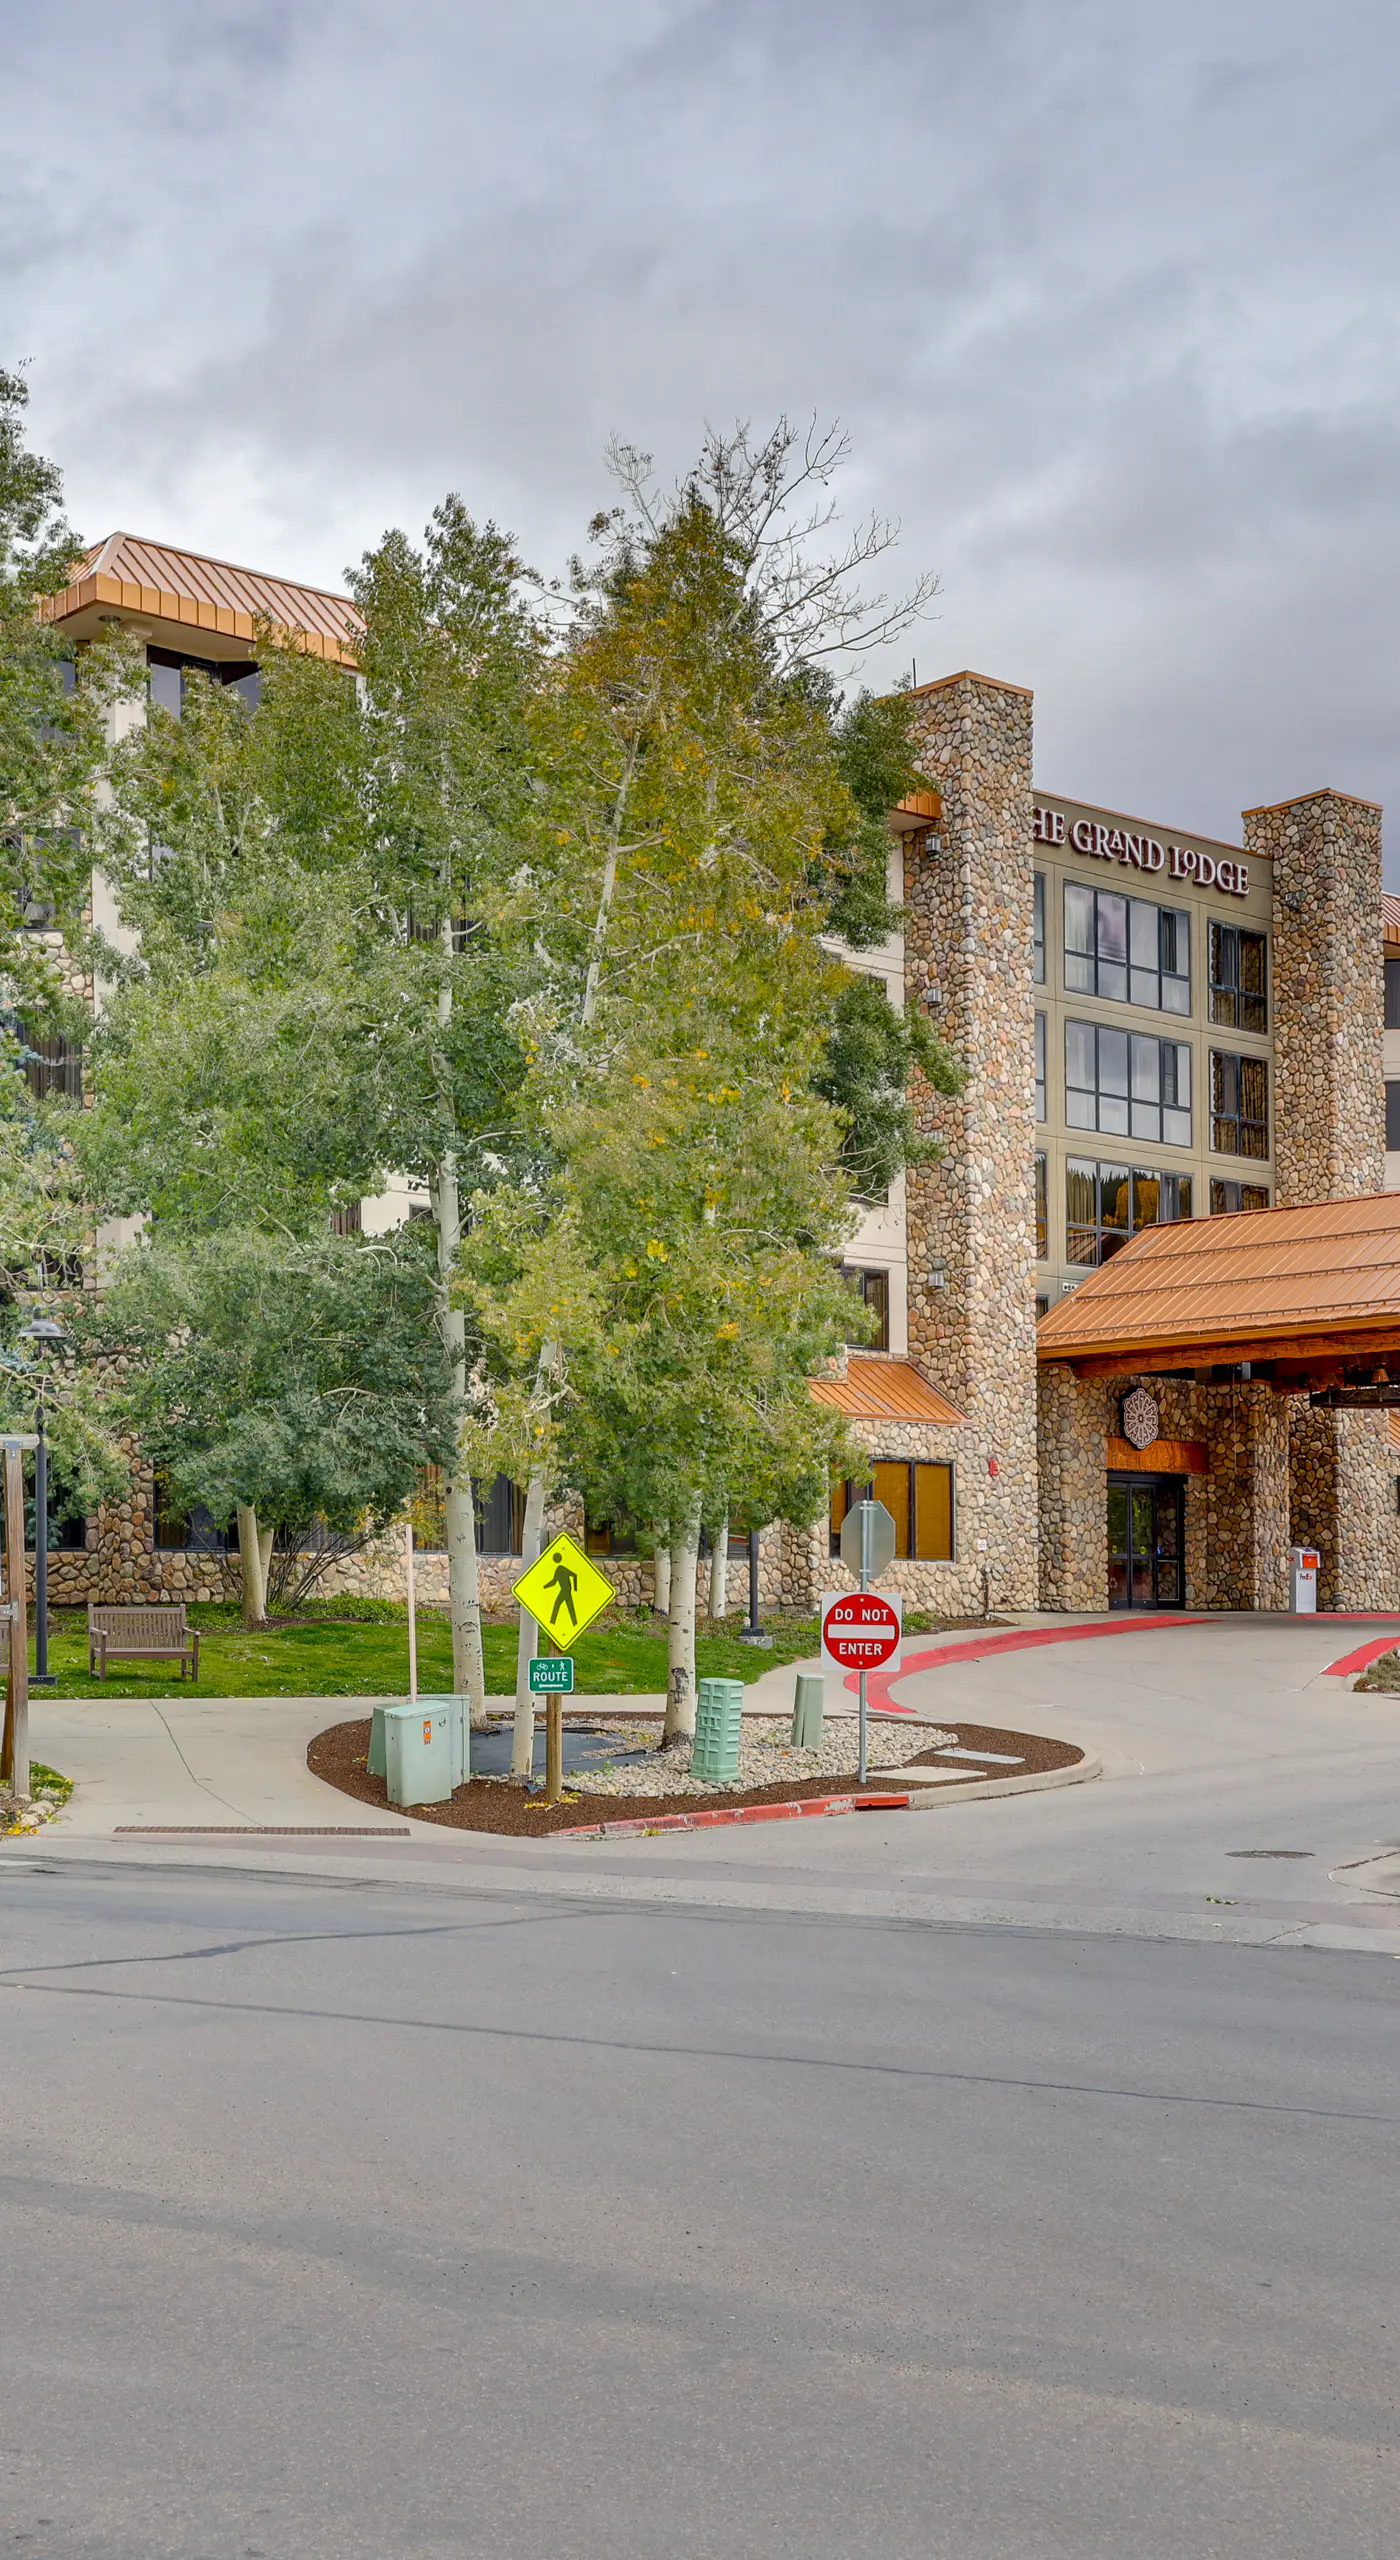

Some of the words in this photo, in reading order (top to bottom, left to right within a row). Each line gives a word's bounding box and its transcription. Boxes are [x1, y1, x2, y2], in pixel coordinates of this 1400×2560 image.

[1033, 806, 1065, 845] HE
[1070, 819, 1165, 872] GRAND
[1169, 845, 1250, 896] LODGE
[835, 1608, 854, 1621] DO
[861, 1608, 889, 1622] NOT
[839, 1642, 883, 1656] ENTER
[533, 1671, 568, 1682] ROUTE
